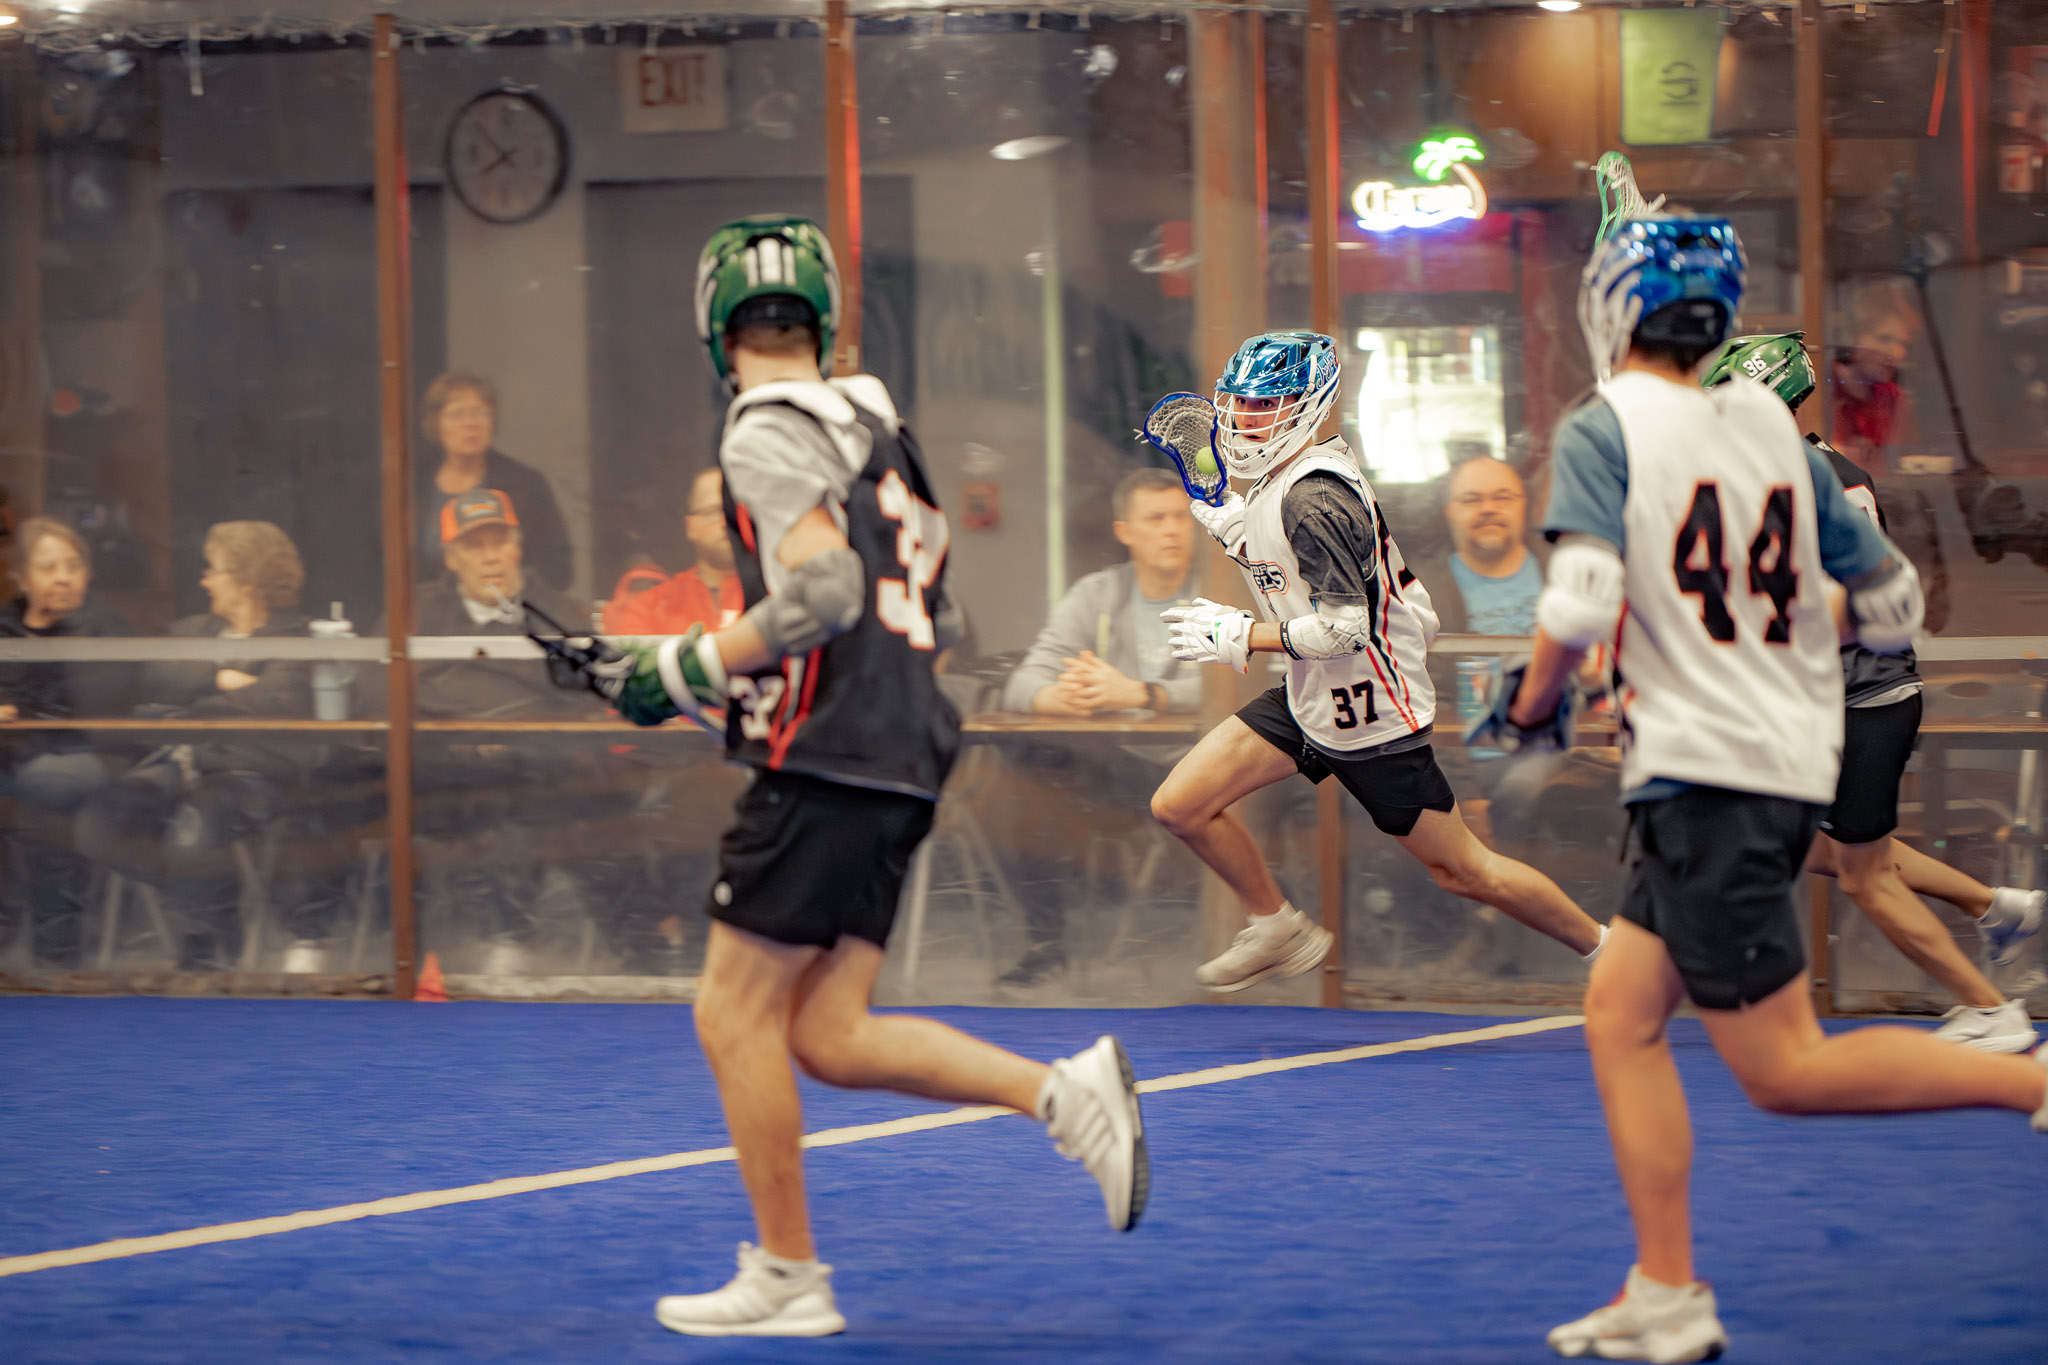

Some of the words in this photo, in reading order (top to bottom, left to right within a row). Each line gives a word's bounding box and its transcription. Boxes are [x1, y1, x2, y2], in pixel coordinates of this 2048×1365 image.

[637, 55, 707, 106] EXIT
[1673, 480, 1800, 643] 44
[1330, 679, 1379, 730] 37
